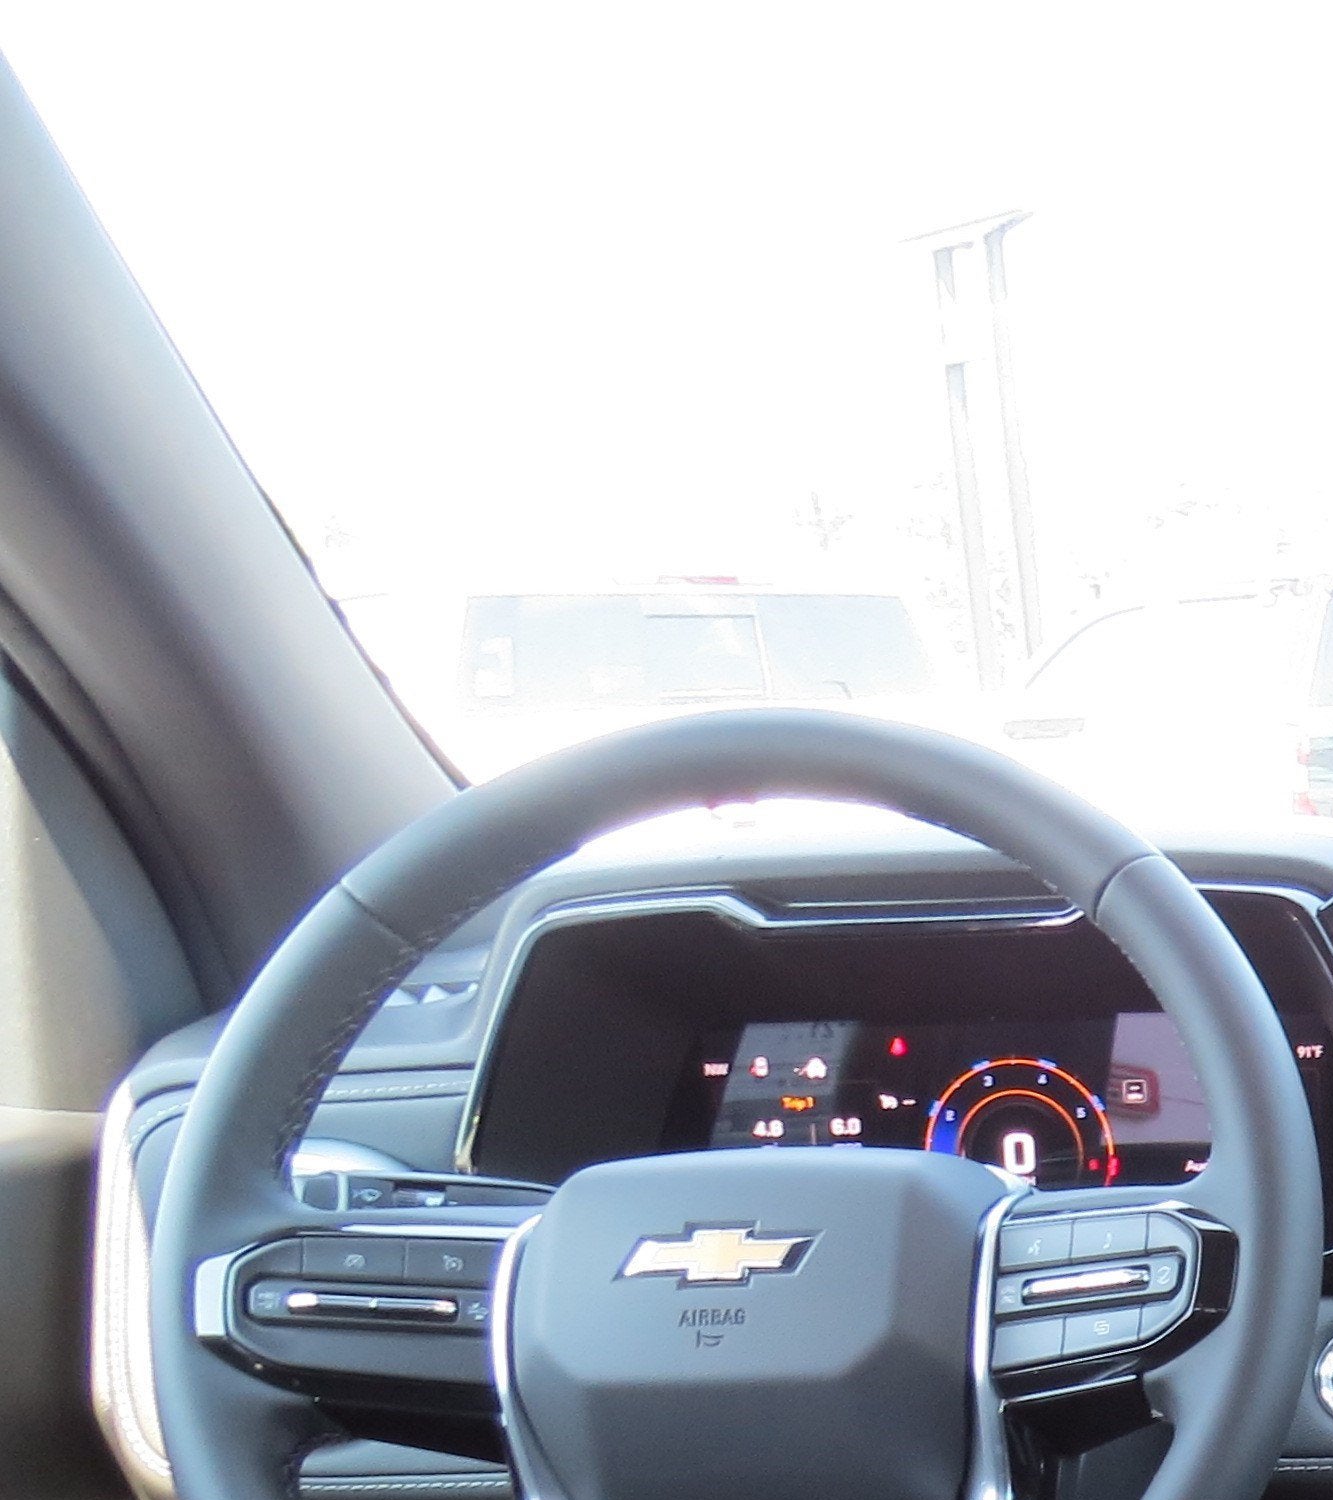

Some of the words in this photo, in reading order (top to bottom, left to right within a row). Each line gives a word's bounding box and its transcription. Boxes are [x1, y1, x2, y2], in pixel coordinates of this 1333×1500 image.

[982, 1074, 994, 1087] 3
[1037, 1072, 1048, 1085] 4
[752, 1119, 784, 1138] 4.8
[829, 1117, 862, 1136] 6.0
[1002, 1132, 1037, 1175] 0
[678, 1307, 746, 1327] AIRBAG
